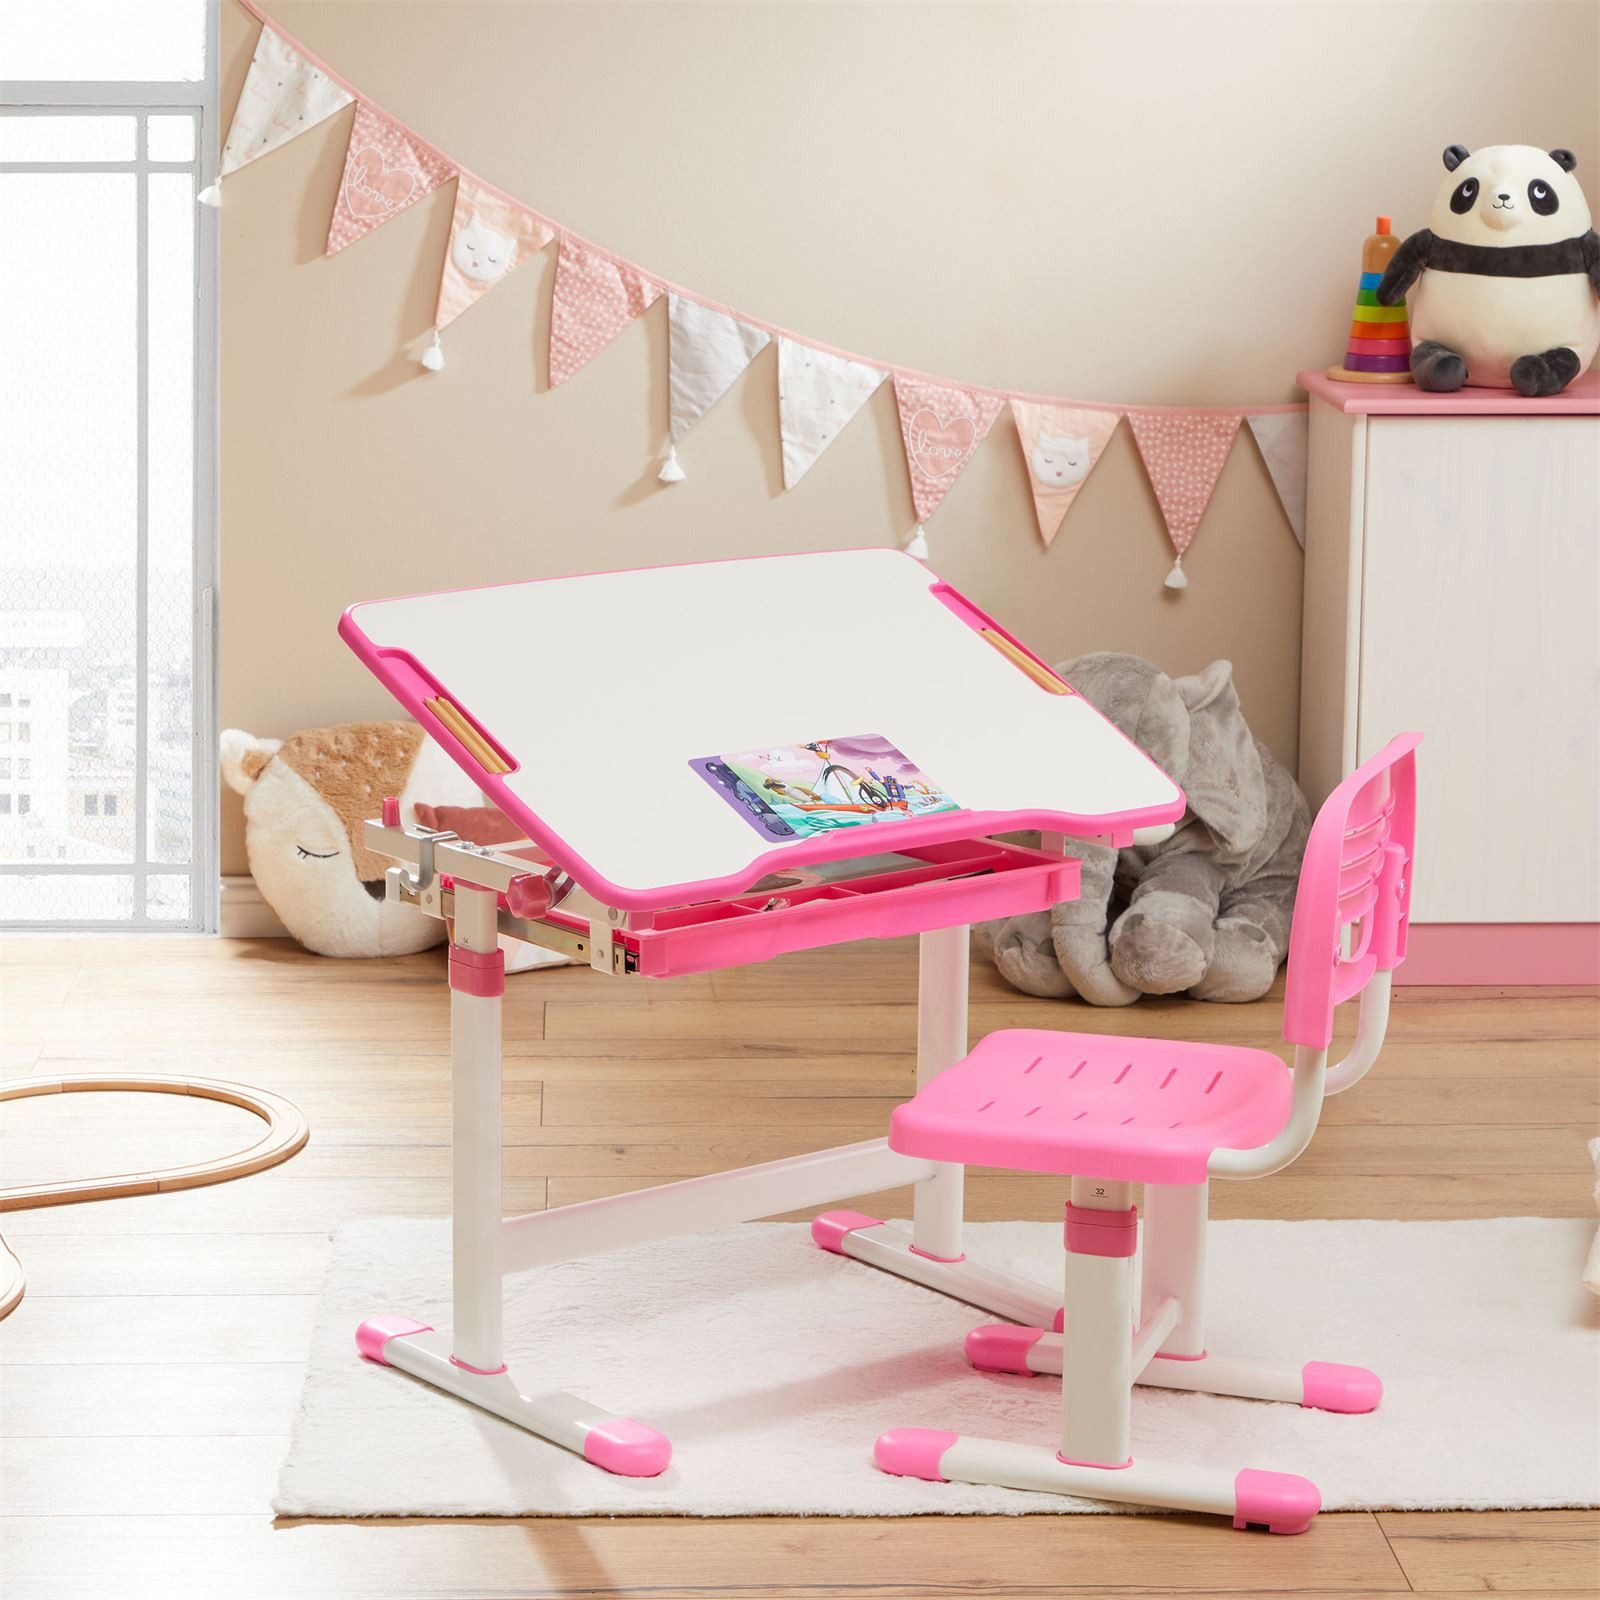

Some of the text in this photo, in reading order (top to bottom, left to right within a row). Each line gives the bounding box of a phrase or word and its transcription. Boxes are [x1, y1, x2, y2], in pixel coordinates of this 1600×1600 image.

[348, 165, 393, 207] love
[915, 429, 963, 457] love
[1095, 1187, 1105, 1196] 32
